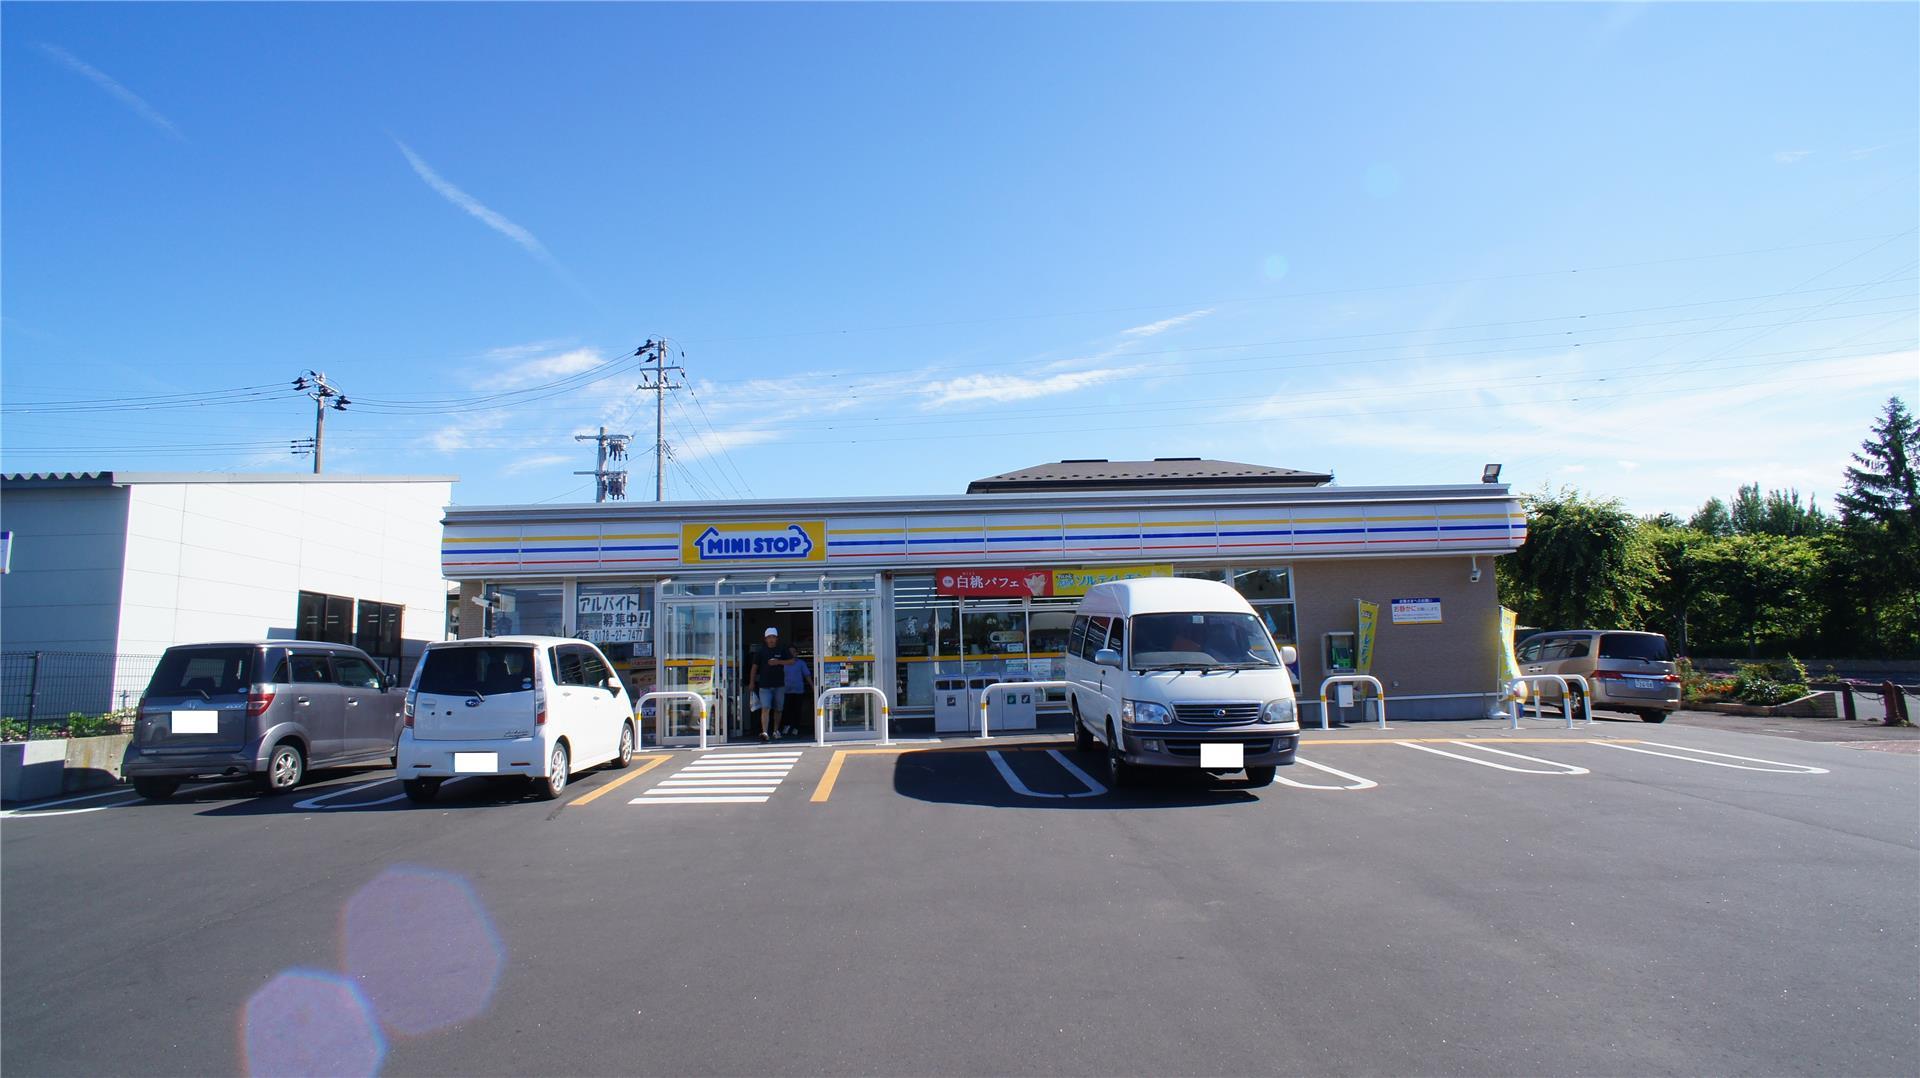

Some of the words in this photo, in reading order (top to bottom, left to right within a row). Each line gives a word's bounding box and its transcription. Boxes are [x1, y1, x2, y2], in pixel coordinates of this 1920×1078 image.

[707, 538, 751, 554] MINI
[753, 536, 802, 553] STOP
[957, 575, 1020, 589] 白桃パフェ
[579, 595, 638, 612] アルバイト
[603, 612, 650, 628] 募集中!!
